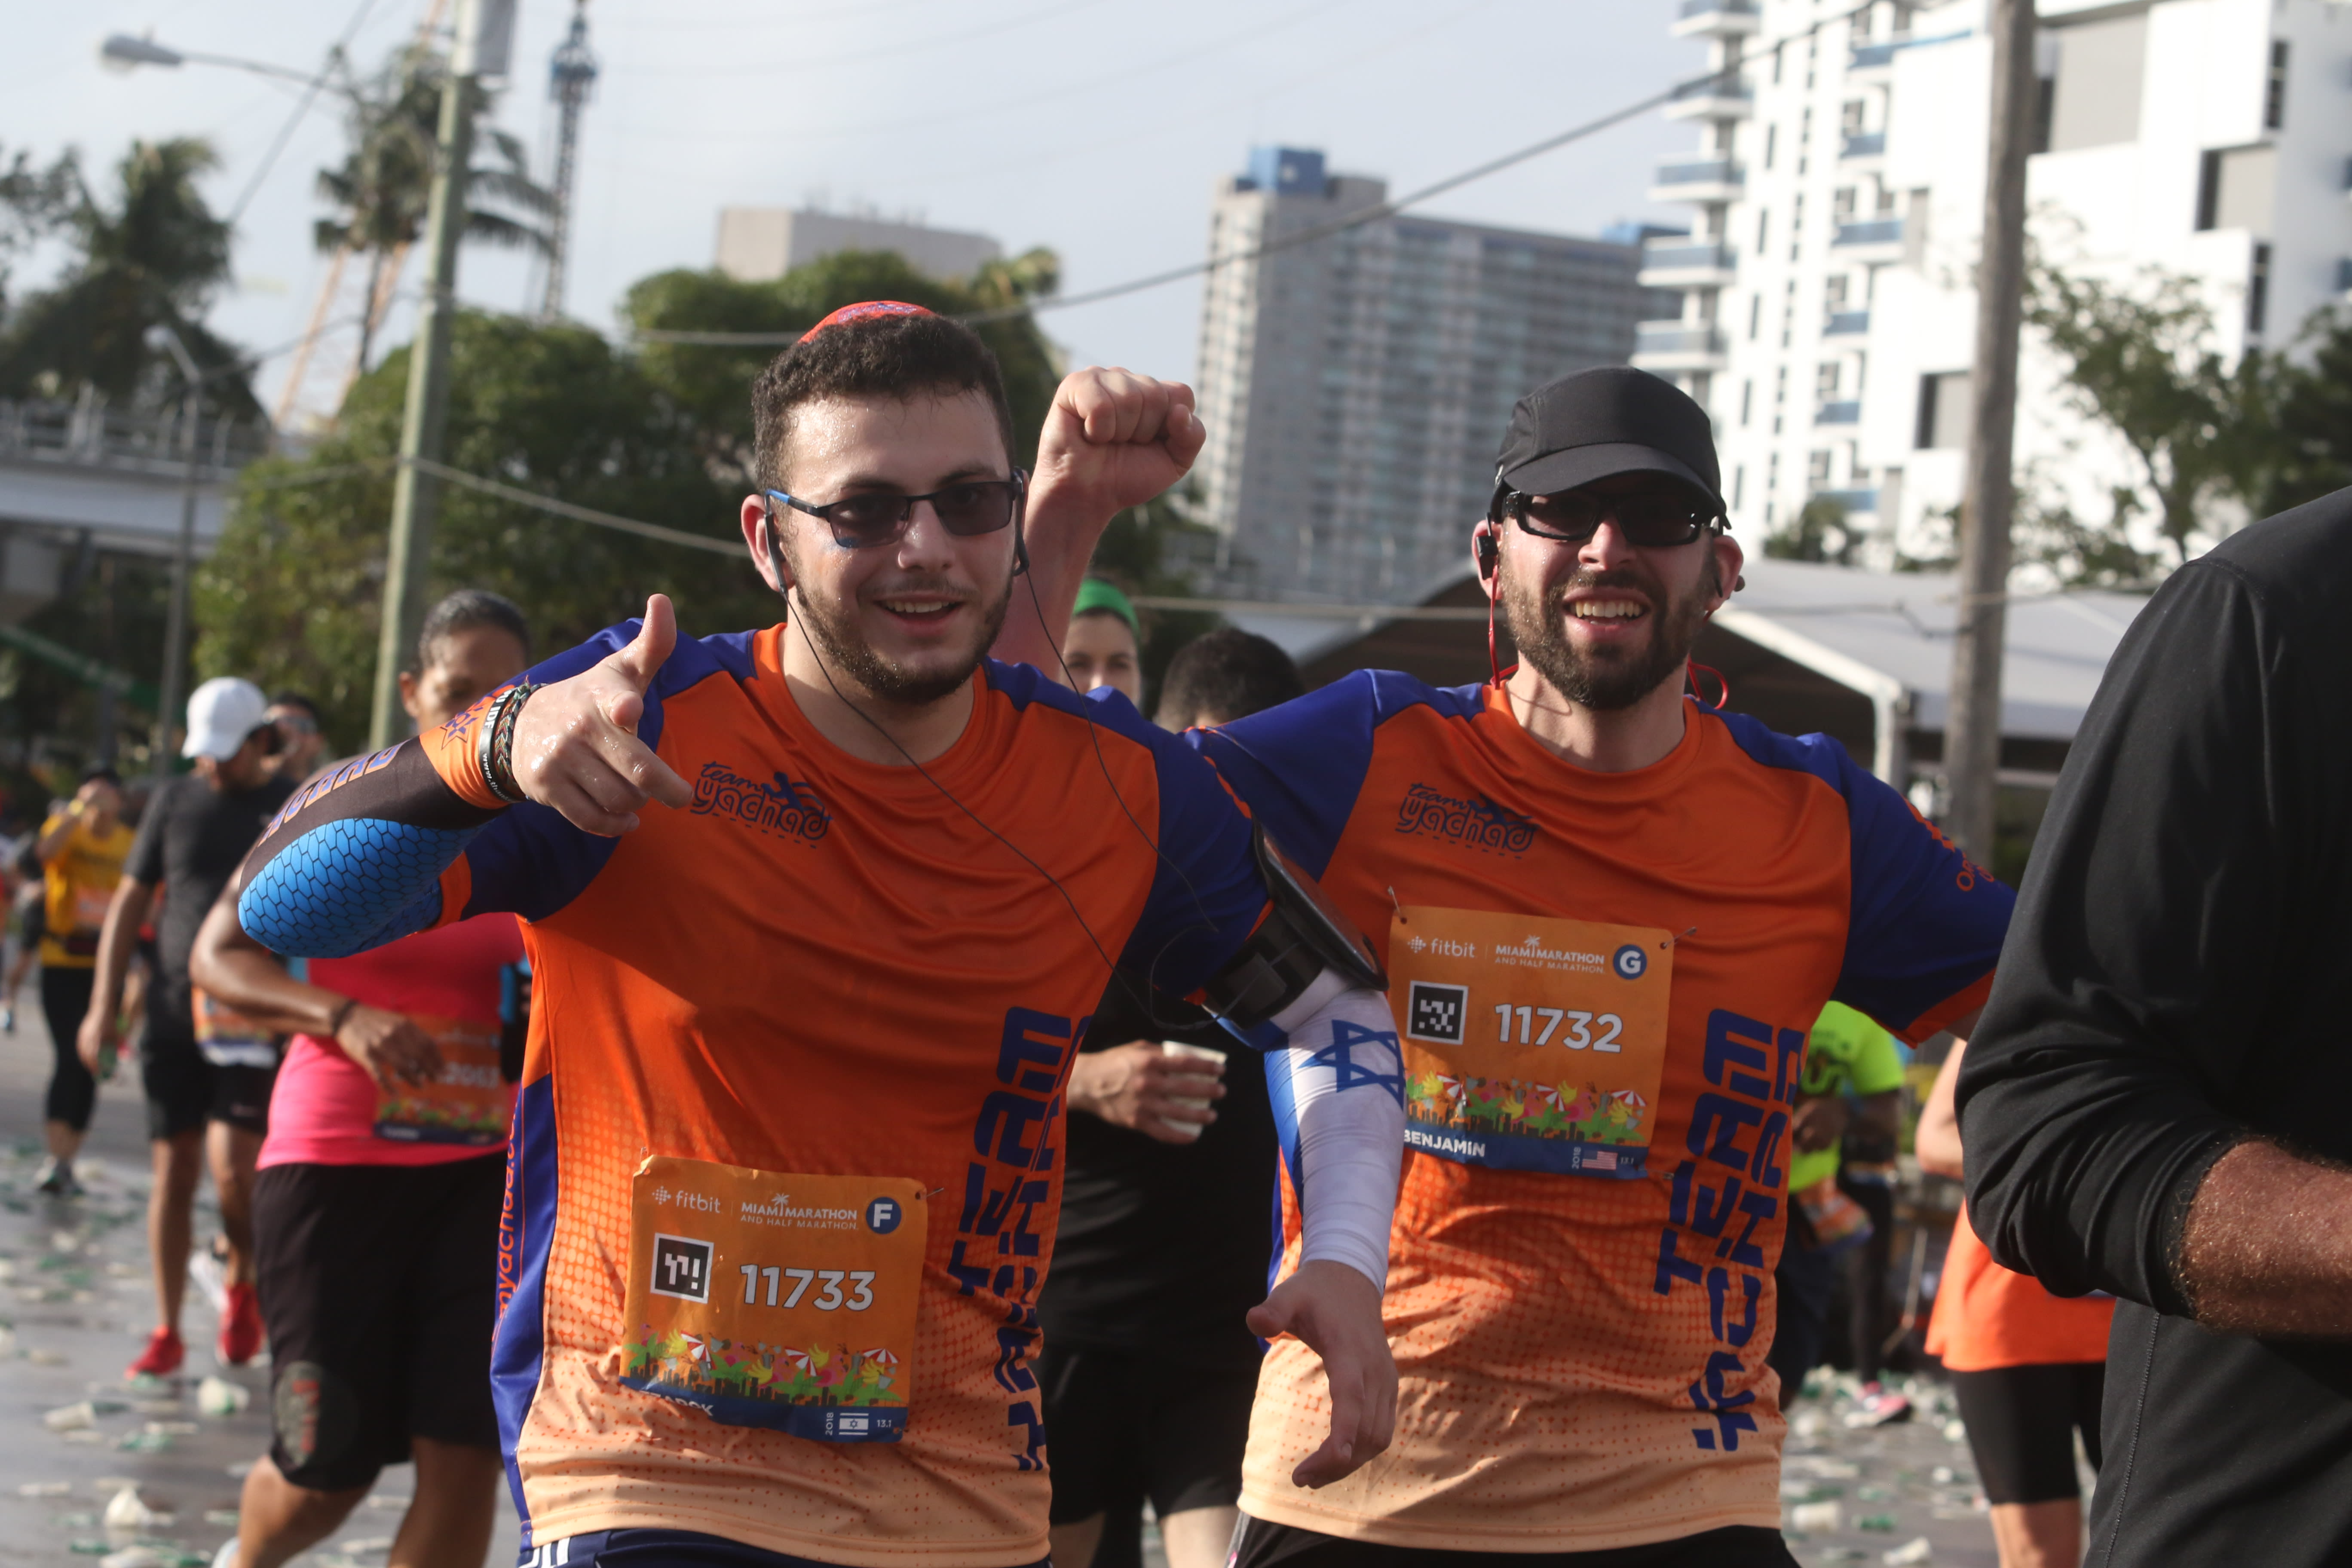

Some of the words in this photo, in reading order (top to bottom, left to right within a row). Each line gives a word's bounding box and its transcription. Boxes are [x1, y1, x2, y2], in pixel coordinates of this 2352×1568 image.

[484, 706, 501, 729] IDF
[701, 761, 762, 792] team
[1408, 782, 1467, 809] team
[690, 778, 830, 841] yachad
[1395, 796, 1534, 853] yachad
[1431, 938, 1476, 958] fitbit
[1495, 957, 1516, 965] AND
[1520, 959, 1543, 968] HALF
[1620, 950, 1641, 974] G
[1495, 1003, 1623, 1054] 11732
[947, 1006, 1072, 1296] TEAM
[1404, 1129, 1486, 1157] BENJAMIN
[1653, 1008, 1773, 1296] TEAM
[1571, 1146, 1581, 1170] 2018
[676, 1191, 721, 1214] fitbit
[740, 1214, 763, 1225] AND
[767, 1217, 793, 1227] HALF
[873, 1203, 893, 1228] F
[740, 1263, 876, 1311] 11733
[825, 1412, 834, 1436] 2018
[876, 1419, 892, 1428] 13.1
